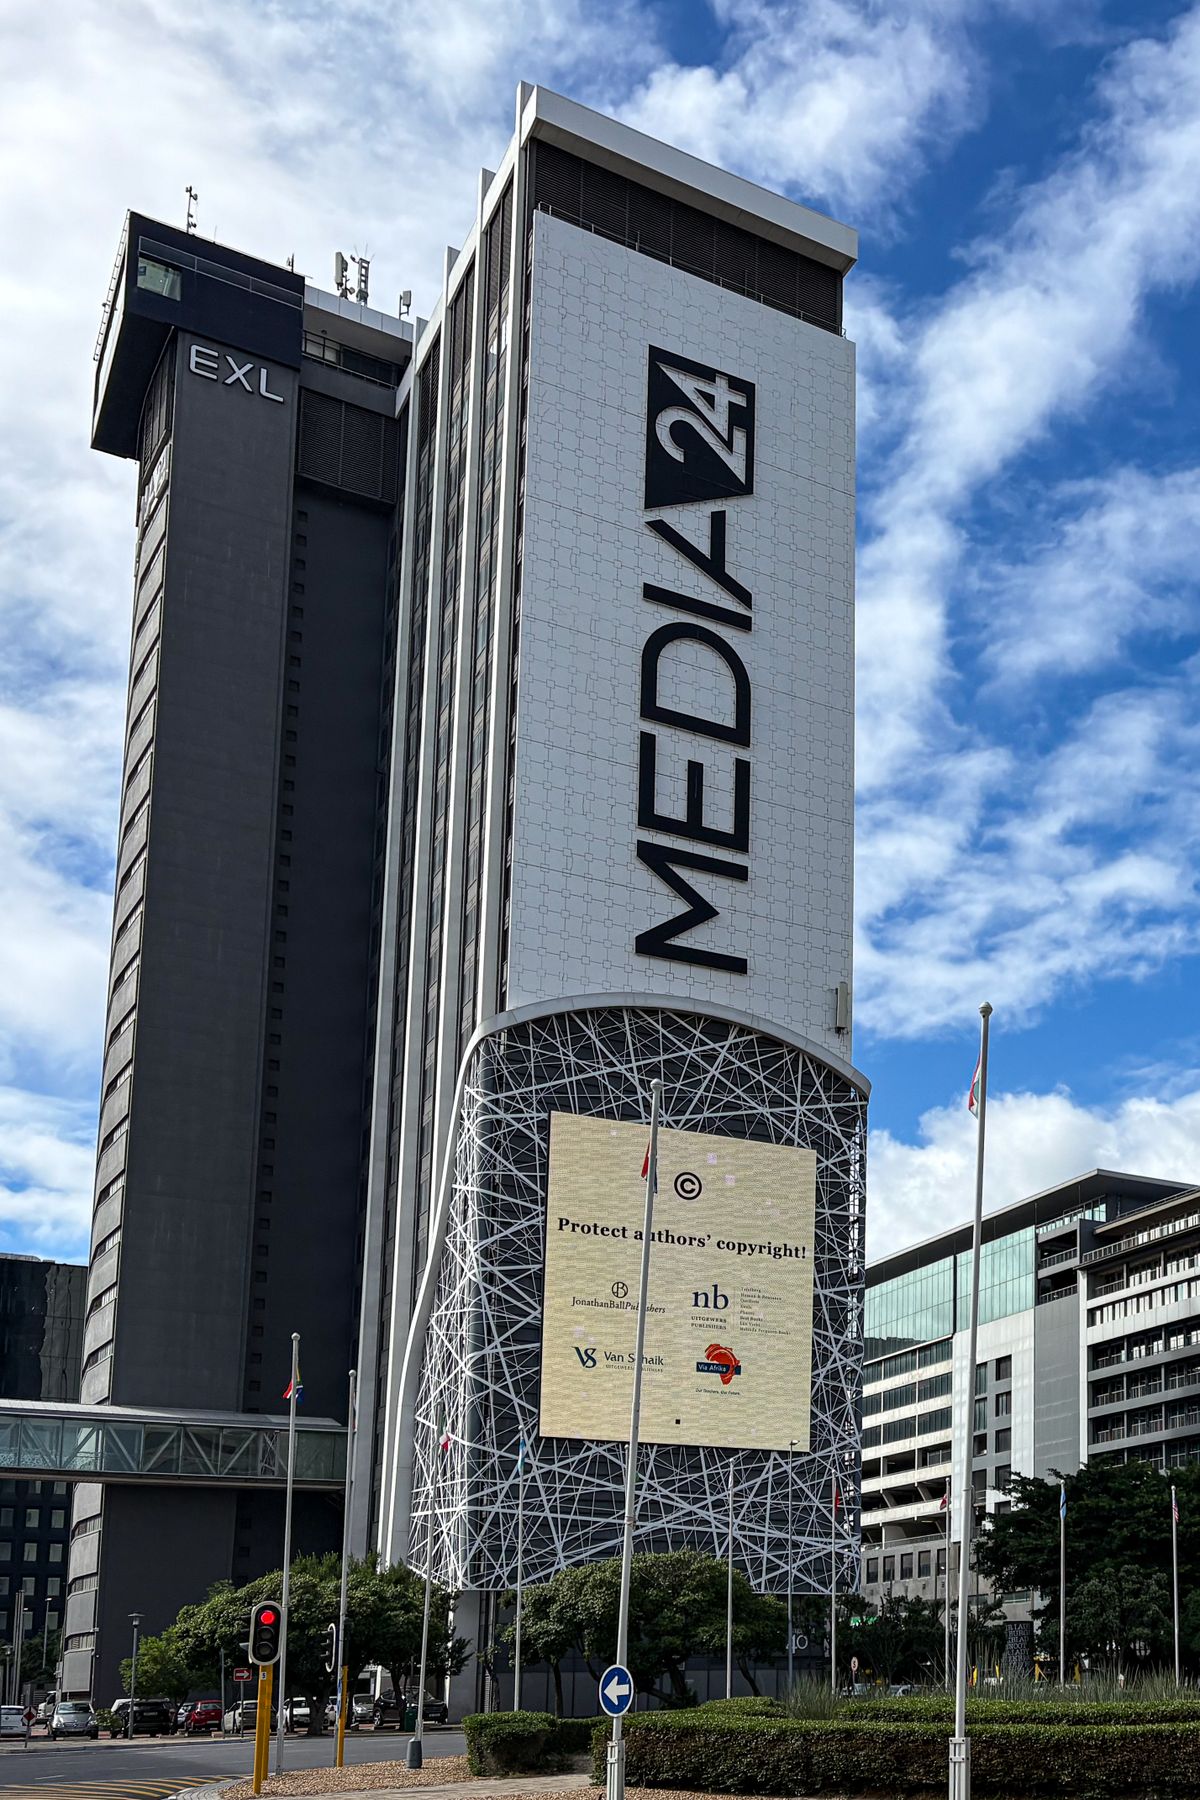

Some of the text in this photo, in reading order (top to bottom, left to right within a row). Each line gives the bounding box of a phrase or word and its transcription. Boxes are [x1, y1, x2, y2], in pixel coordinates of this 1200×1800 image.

[189, 344, 284, 403] EXL
[557, 1217, 629, 1239] Protect
[716, 1239, 807, 1260] copyright!
[692, 1284, 729, 1310] nb
[604, 1351, 664, 1366] Van Shaik
